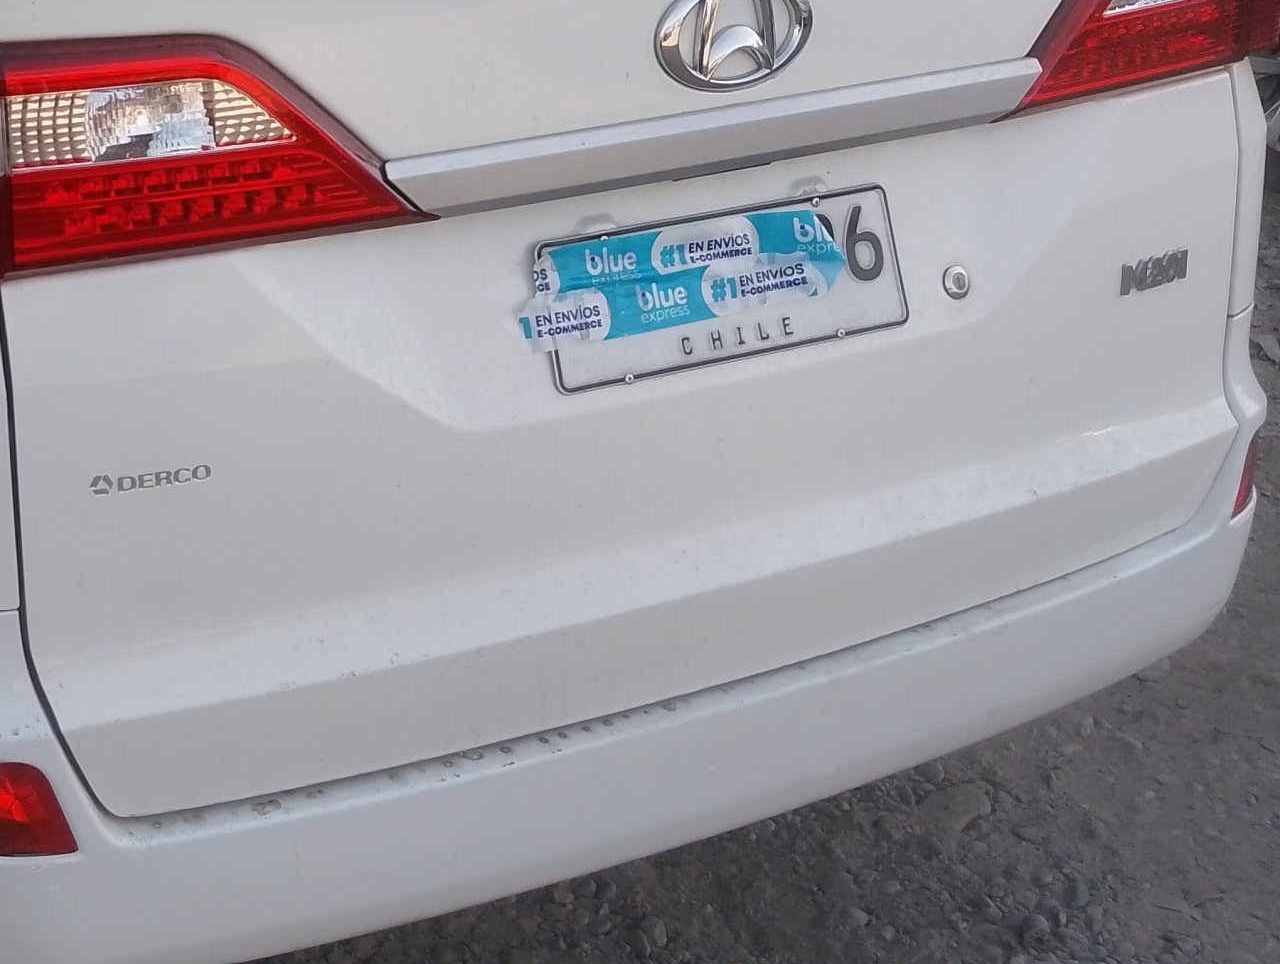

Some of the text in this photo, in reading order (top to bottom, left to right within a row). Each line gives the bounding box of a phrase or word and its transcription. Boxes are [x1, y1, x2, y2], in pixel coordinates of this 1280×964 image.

[584, 247, 637, 276] blue
[660, 243, 688, 269] #1
[688, 240, 705, 254] EN
[689, 247, 753, 264] E-COMMERCE
[636, 282, 689, 312] blue
[710, 276, 738, 303] #1
[739, 274, 754, 288] EN
[740, 276, 809, 298] E-COMMERCE
[535, 313, 553, 328] EN
[537, 319, 603, 338] E-COMMERCE
[641, 305, 691, 325] express
[681, 316, 794, 356] CHILE
[117, 464, 212, 493] DERCO
